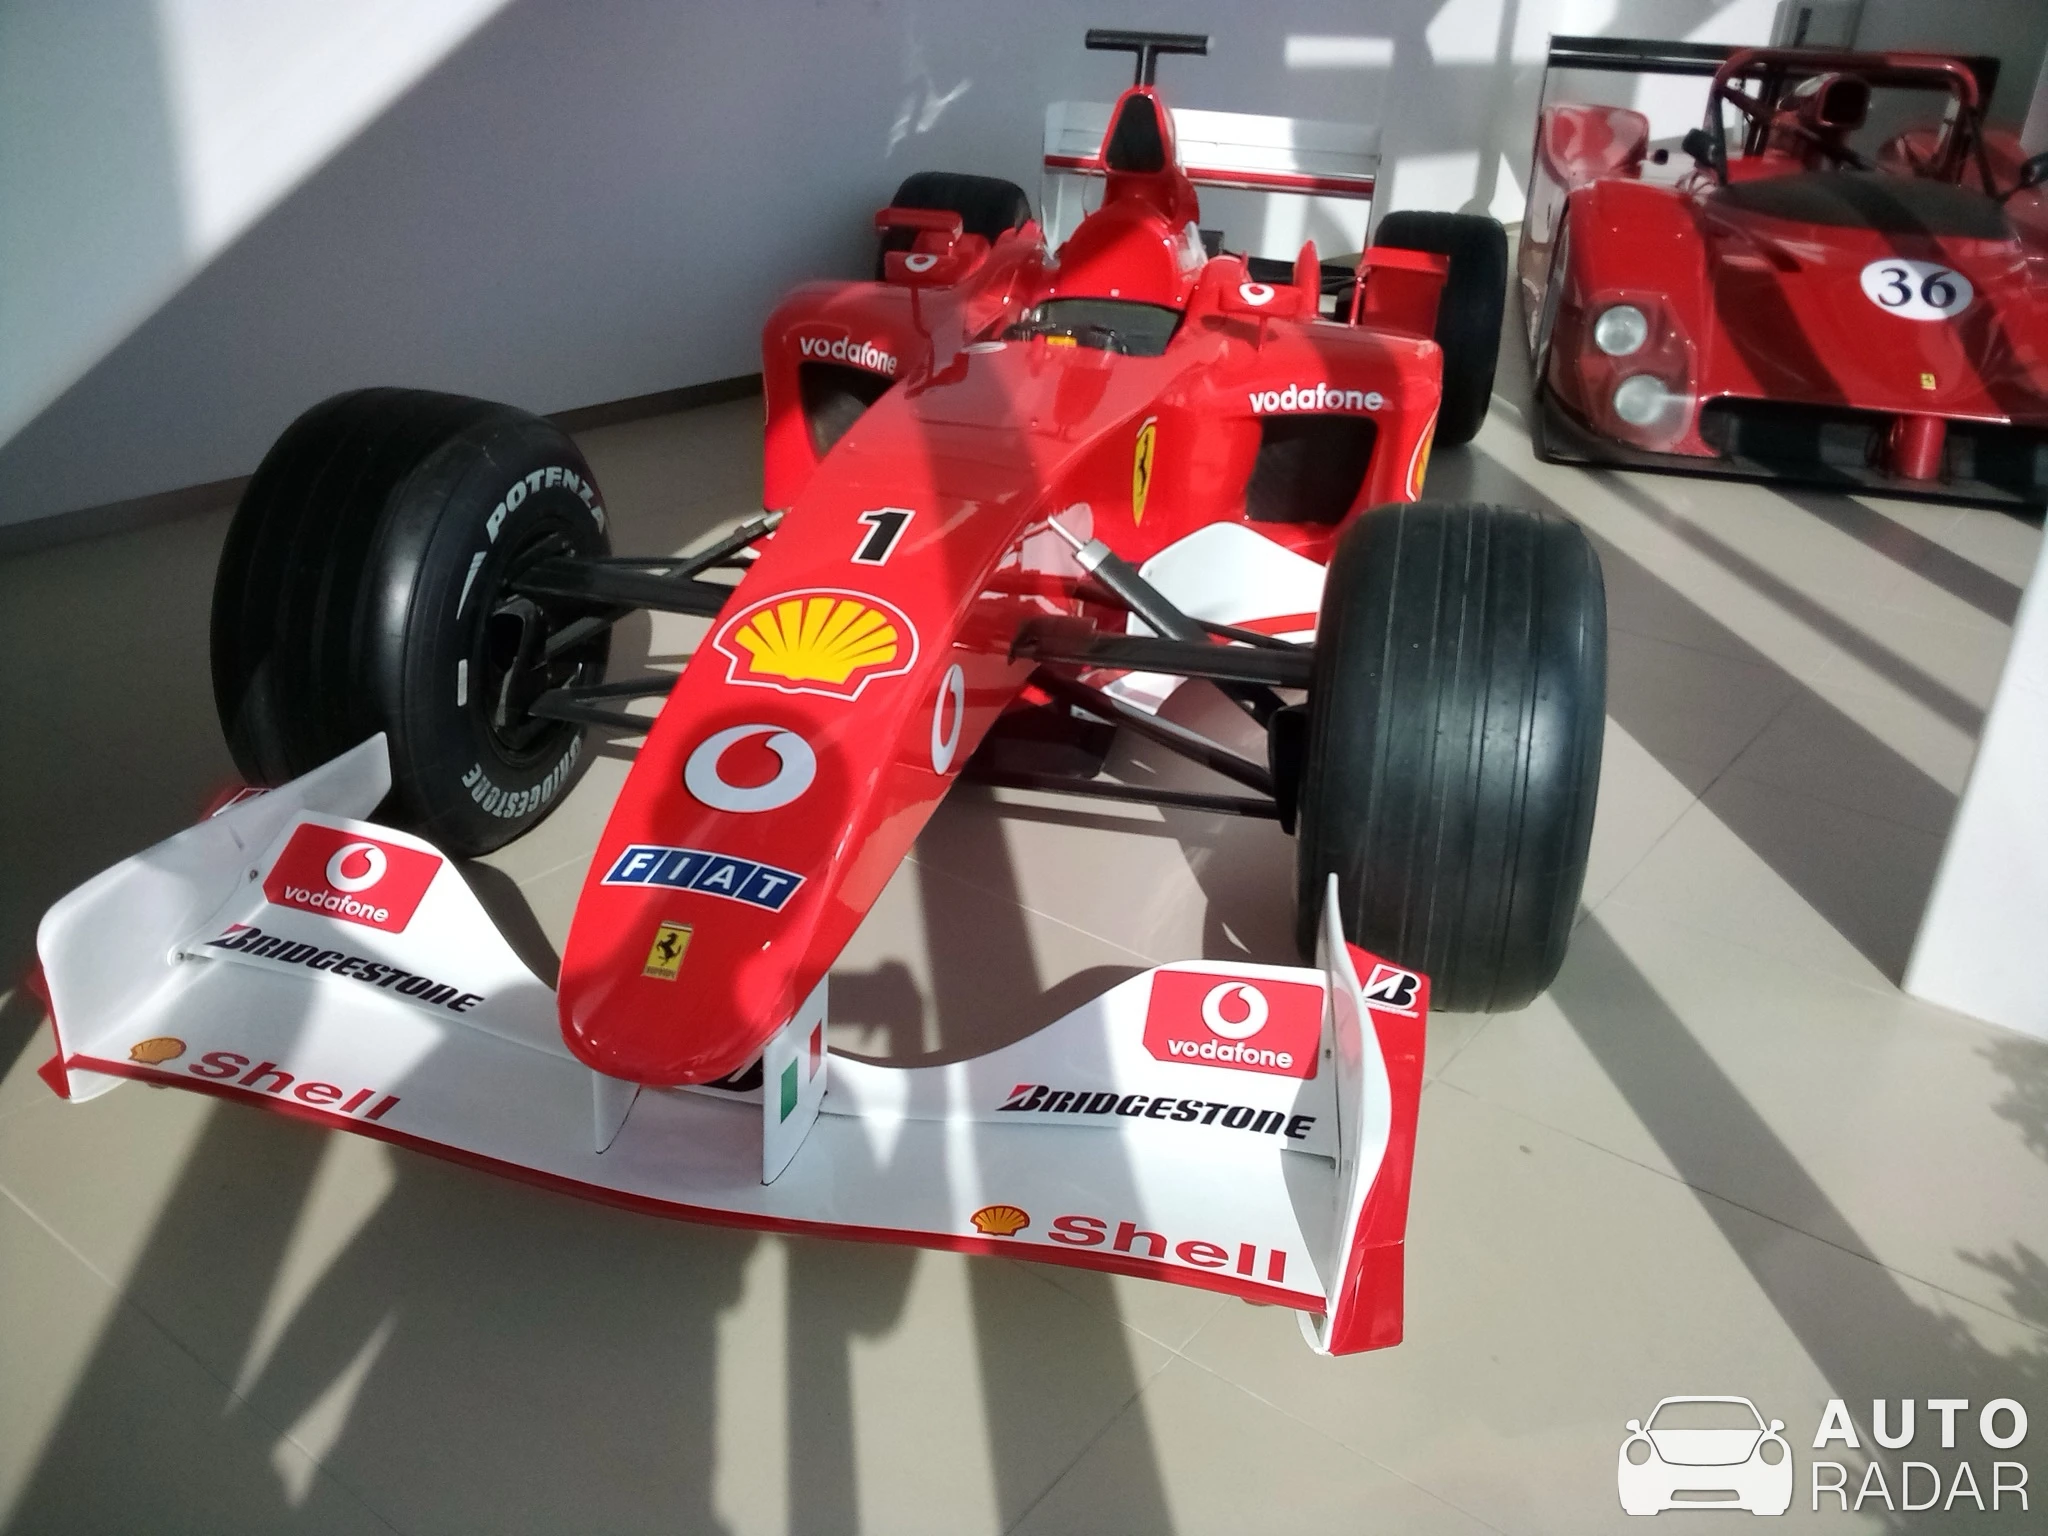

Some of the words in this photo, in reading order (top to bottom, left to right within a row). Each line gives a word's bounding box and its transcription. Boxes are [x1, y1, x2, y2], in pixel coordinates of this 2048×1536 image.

[1877, 267, 1957, 309] 36
[799, 334, 898, 376] vodafone
[1249, 384, 1384, 414] vodafone
[854, 508, 915, 565] 1
[622, 853, 790, 900] FIAT
[284, 883, 389, 923] vodafone
[203, 923, 485, 1013] BRIDGESTONE
[1167, 1038, 1293, 1070] vodafone
[188, 1051, 402, 1121] Shell
[996, 1084, 1317, 1140] BRIDGESTONE
[1048, 1215, 1288, 1284] Shell
